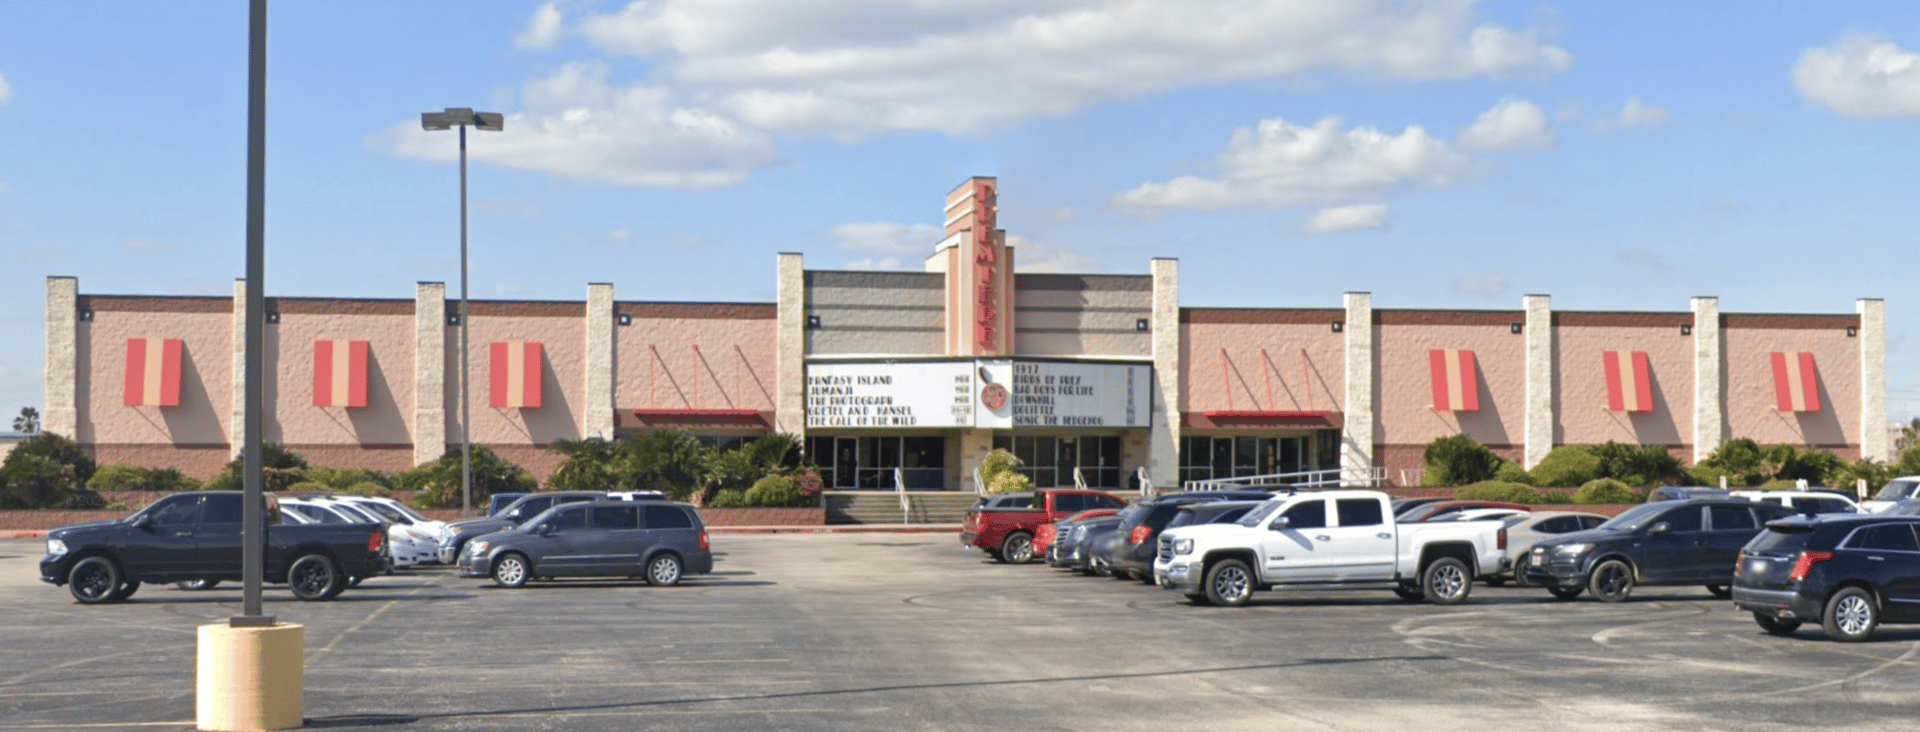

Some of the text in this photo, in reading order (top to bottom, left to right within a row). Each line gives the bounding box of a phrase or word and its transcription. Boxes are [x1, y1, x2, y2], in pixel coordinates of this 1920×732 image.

[976, 184, 996, 349] PREMIERE
[1015, 365, 1039, 373] 1917
[808, 375, 892, 385] FANTASY ISLAND
[1014, 375, 1081, 384] BIRDS OF PREY
[810, 386, 853, 395] JUMANJI
[1014, 385, 1094, 395] BAD BOYS FOR LIFE
[809, 396, 893, 405] THE PHOTOGRAPH
[1014, 395, 1055, 404] DOWNHILL
[808, 406, 912, 415] GRETEL AND HANSEL
[1014, 405, 1054, 414] DOLITTLE
[809, 416, 917, 425] THE CALL OF THE WILD
[1014, 416, 1104, 425] SONIC THE HEDGEHOG
